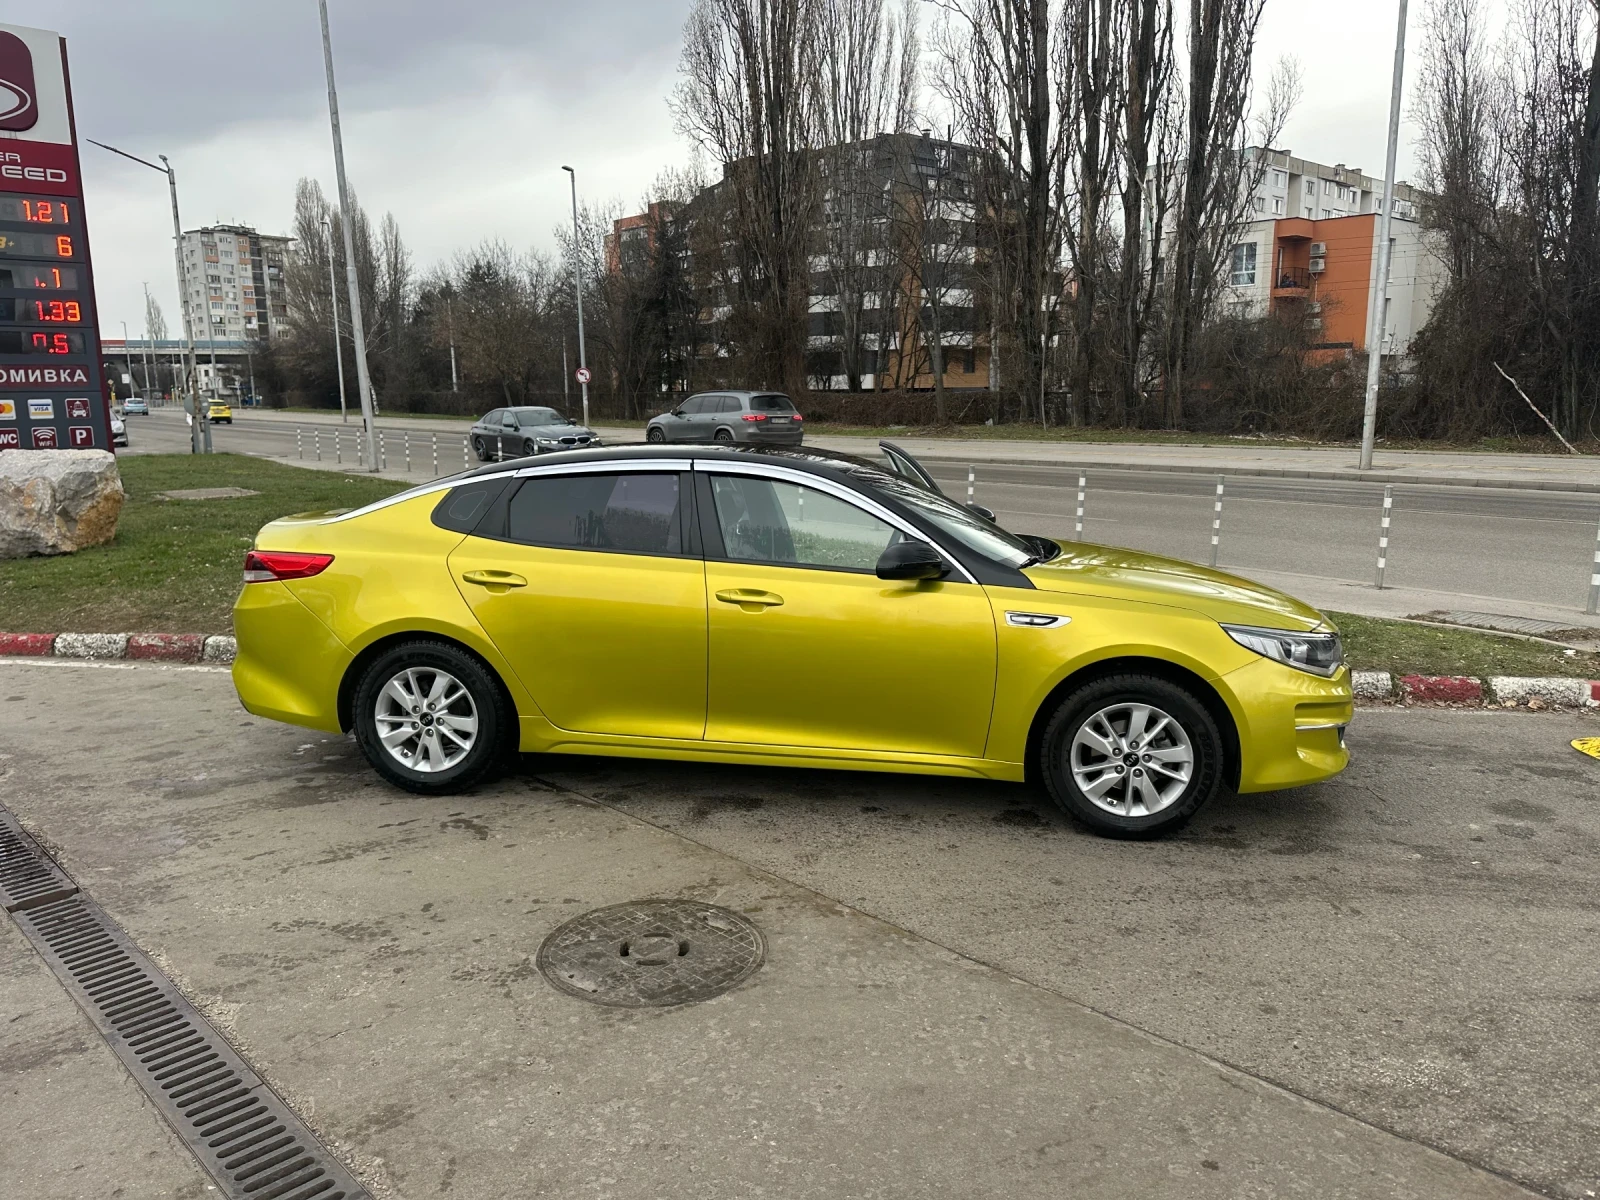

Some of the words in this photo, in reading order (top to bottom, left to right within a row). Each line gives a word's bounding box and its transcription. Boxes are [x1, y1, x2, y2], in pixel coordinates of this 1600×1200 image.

[1, 165, 67, 183] EED
[57, 235, 73, 257] 6
[35, 301, 81, 321] 1.33
[75, 429, 87, 445] P
